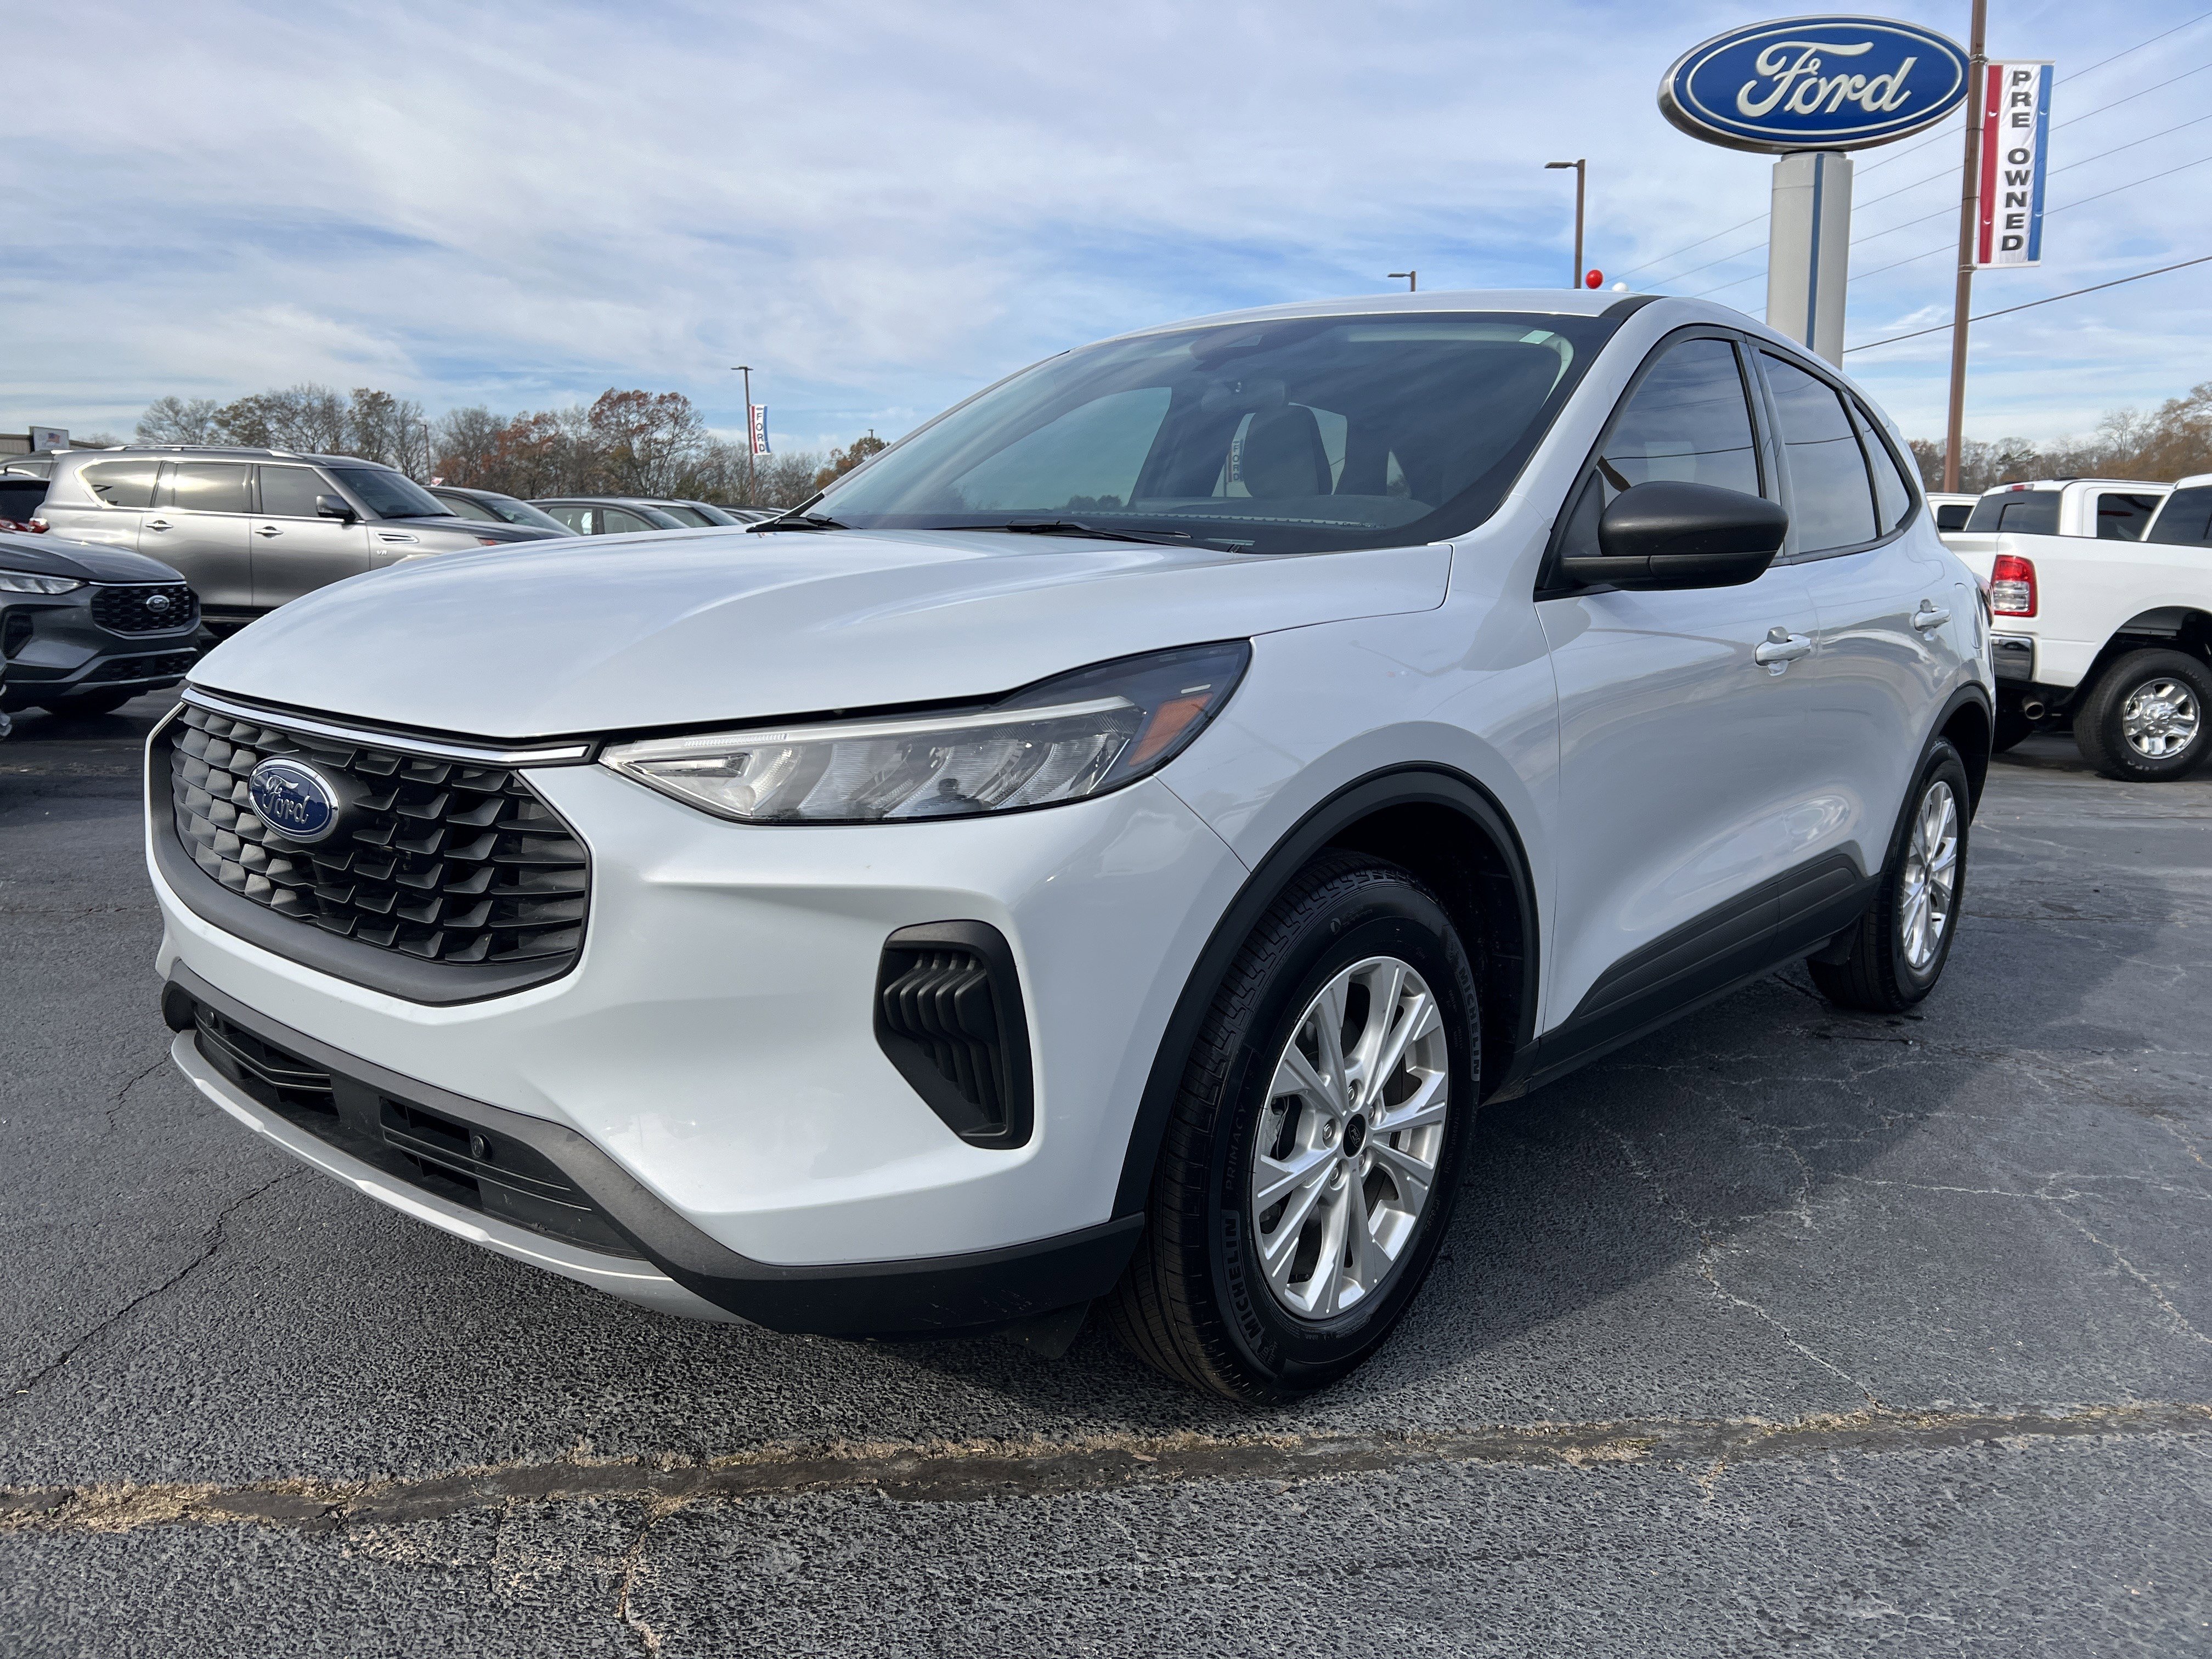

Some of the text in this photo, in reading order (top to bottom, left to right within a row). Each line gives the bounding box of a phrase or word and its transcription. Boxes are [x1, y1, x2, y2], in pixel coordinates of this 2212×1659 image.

[1736, 41, 1918, 117] Ford
[2001, 70, 2032, 252] PRE OWNED
[755, 413, 765, 452] FORD
[262, 774, 311, 824] Ford
[1459, 966, 1480, 1075] MICHELIN
[1225, 1102, 1246, 1190] PRIMACY
[1225, 1218, 1262, 1340] MICHELIN
